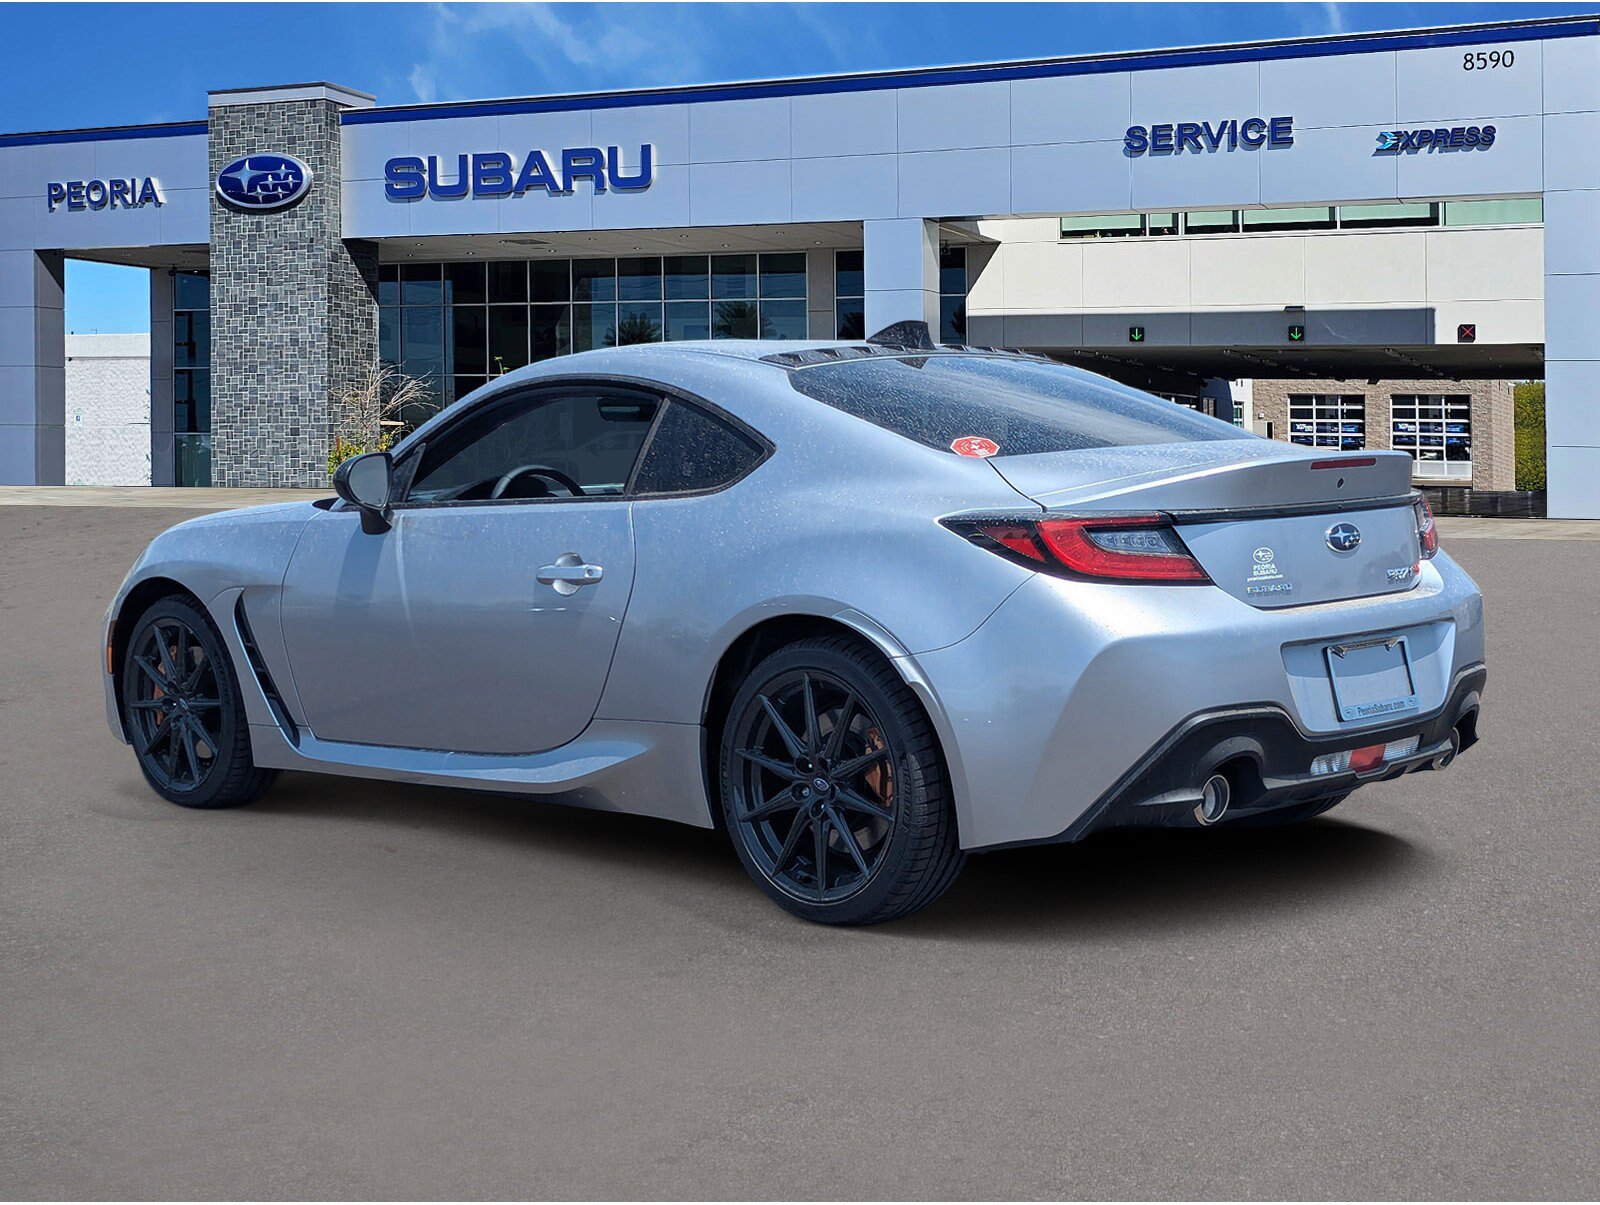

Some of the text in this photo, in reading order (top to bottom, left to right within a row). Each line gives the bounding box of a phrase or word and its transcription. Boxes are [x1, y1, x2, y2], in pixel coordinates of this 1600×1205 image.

[1462, 49, 1515, 71] 8590
[1125, 116, 1294, 151] SERVICE
[1375, 125, 1497, 150] EXPRESS
[384, 144, 652, 198] SUBARU
[47, 177, 161, 209] PEORIA
